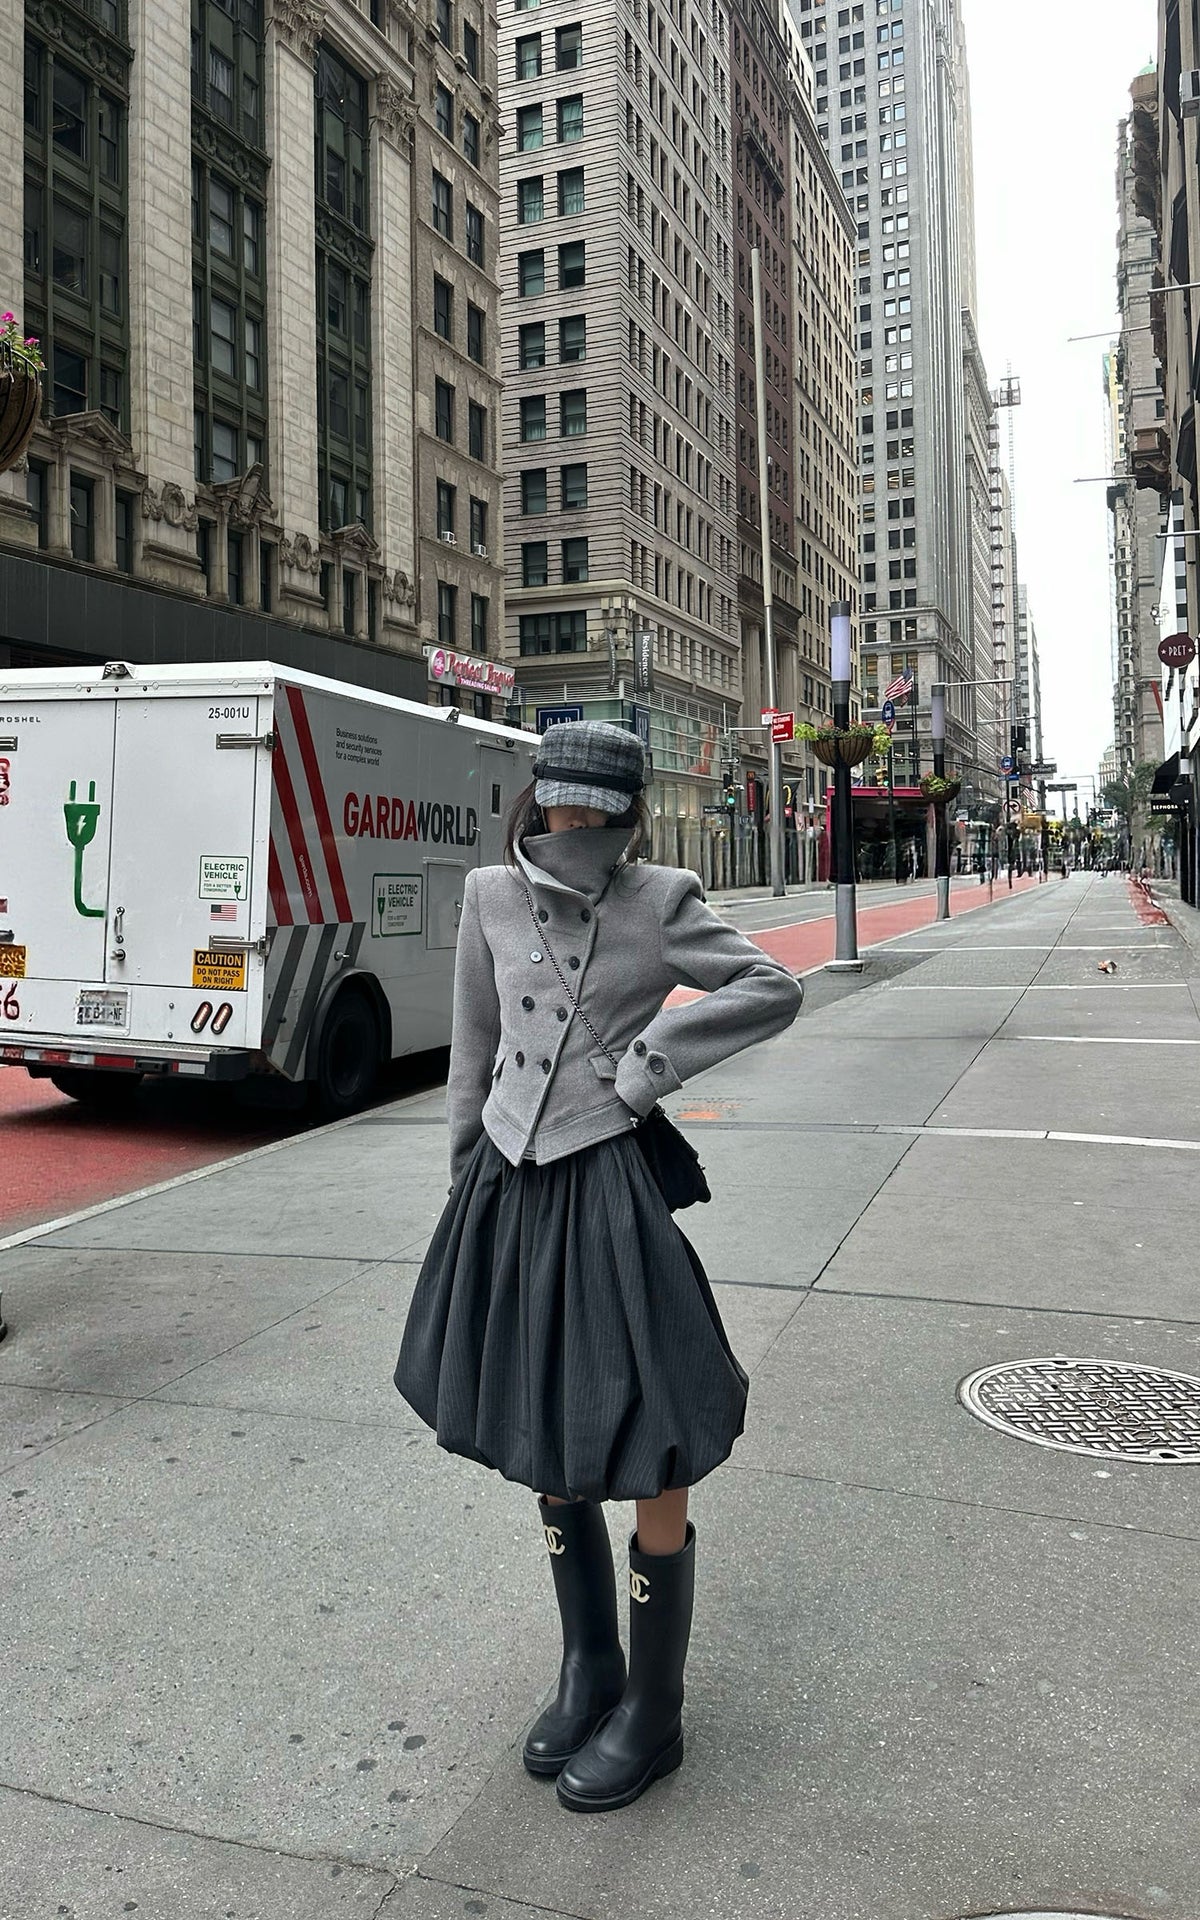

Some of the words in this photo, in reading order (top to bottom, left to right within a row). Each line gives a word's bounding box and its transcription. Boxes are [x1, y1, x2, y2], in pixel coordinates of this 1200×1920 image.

[642, 635, 650, 676] Residence
[1168, 645, 1187, 656] PRET
[446, 652, 484, 682] Perfect
[208, 707, 250, 719] 25-001U
[336, 727, 357, 741] Business
[357, 734, 378, 744] solutions
[336, 740, 346, 749] and
[346, 743, 364, 755] security
[364, 746, 383, 757] services
[335, 750, 343, 760] for
[347, 753, 367, 764] complex
[366, 756, 380, 767] world
[343, 791, 478, 847] GARDAWORLD
[204, 862, 245, 872] ELECTRIC
[204, 871, 239, 880] VEHICLE
[388, 883, 419, 895] ELECTRIC
[388, 896, 414, 907] VEHICLE
[197, 952, 242, 967] CAUTION
[197, 967, 206, 975] DO
[208, 968, 221, 976] NOT
[223, 969, 241, 978] PASS
[202, 975, 212, 983] ON
[213, 976, 234, 985] RIGHT
